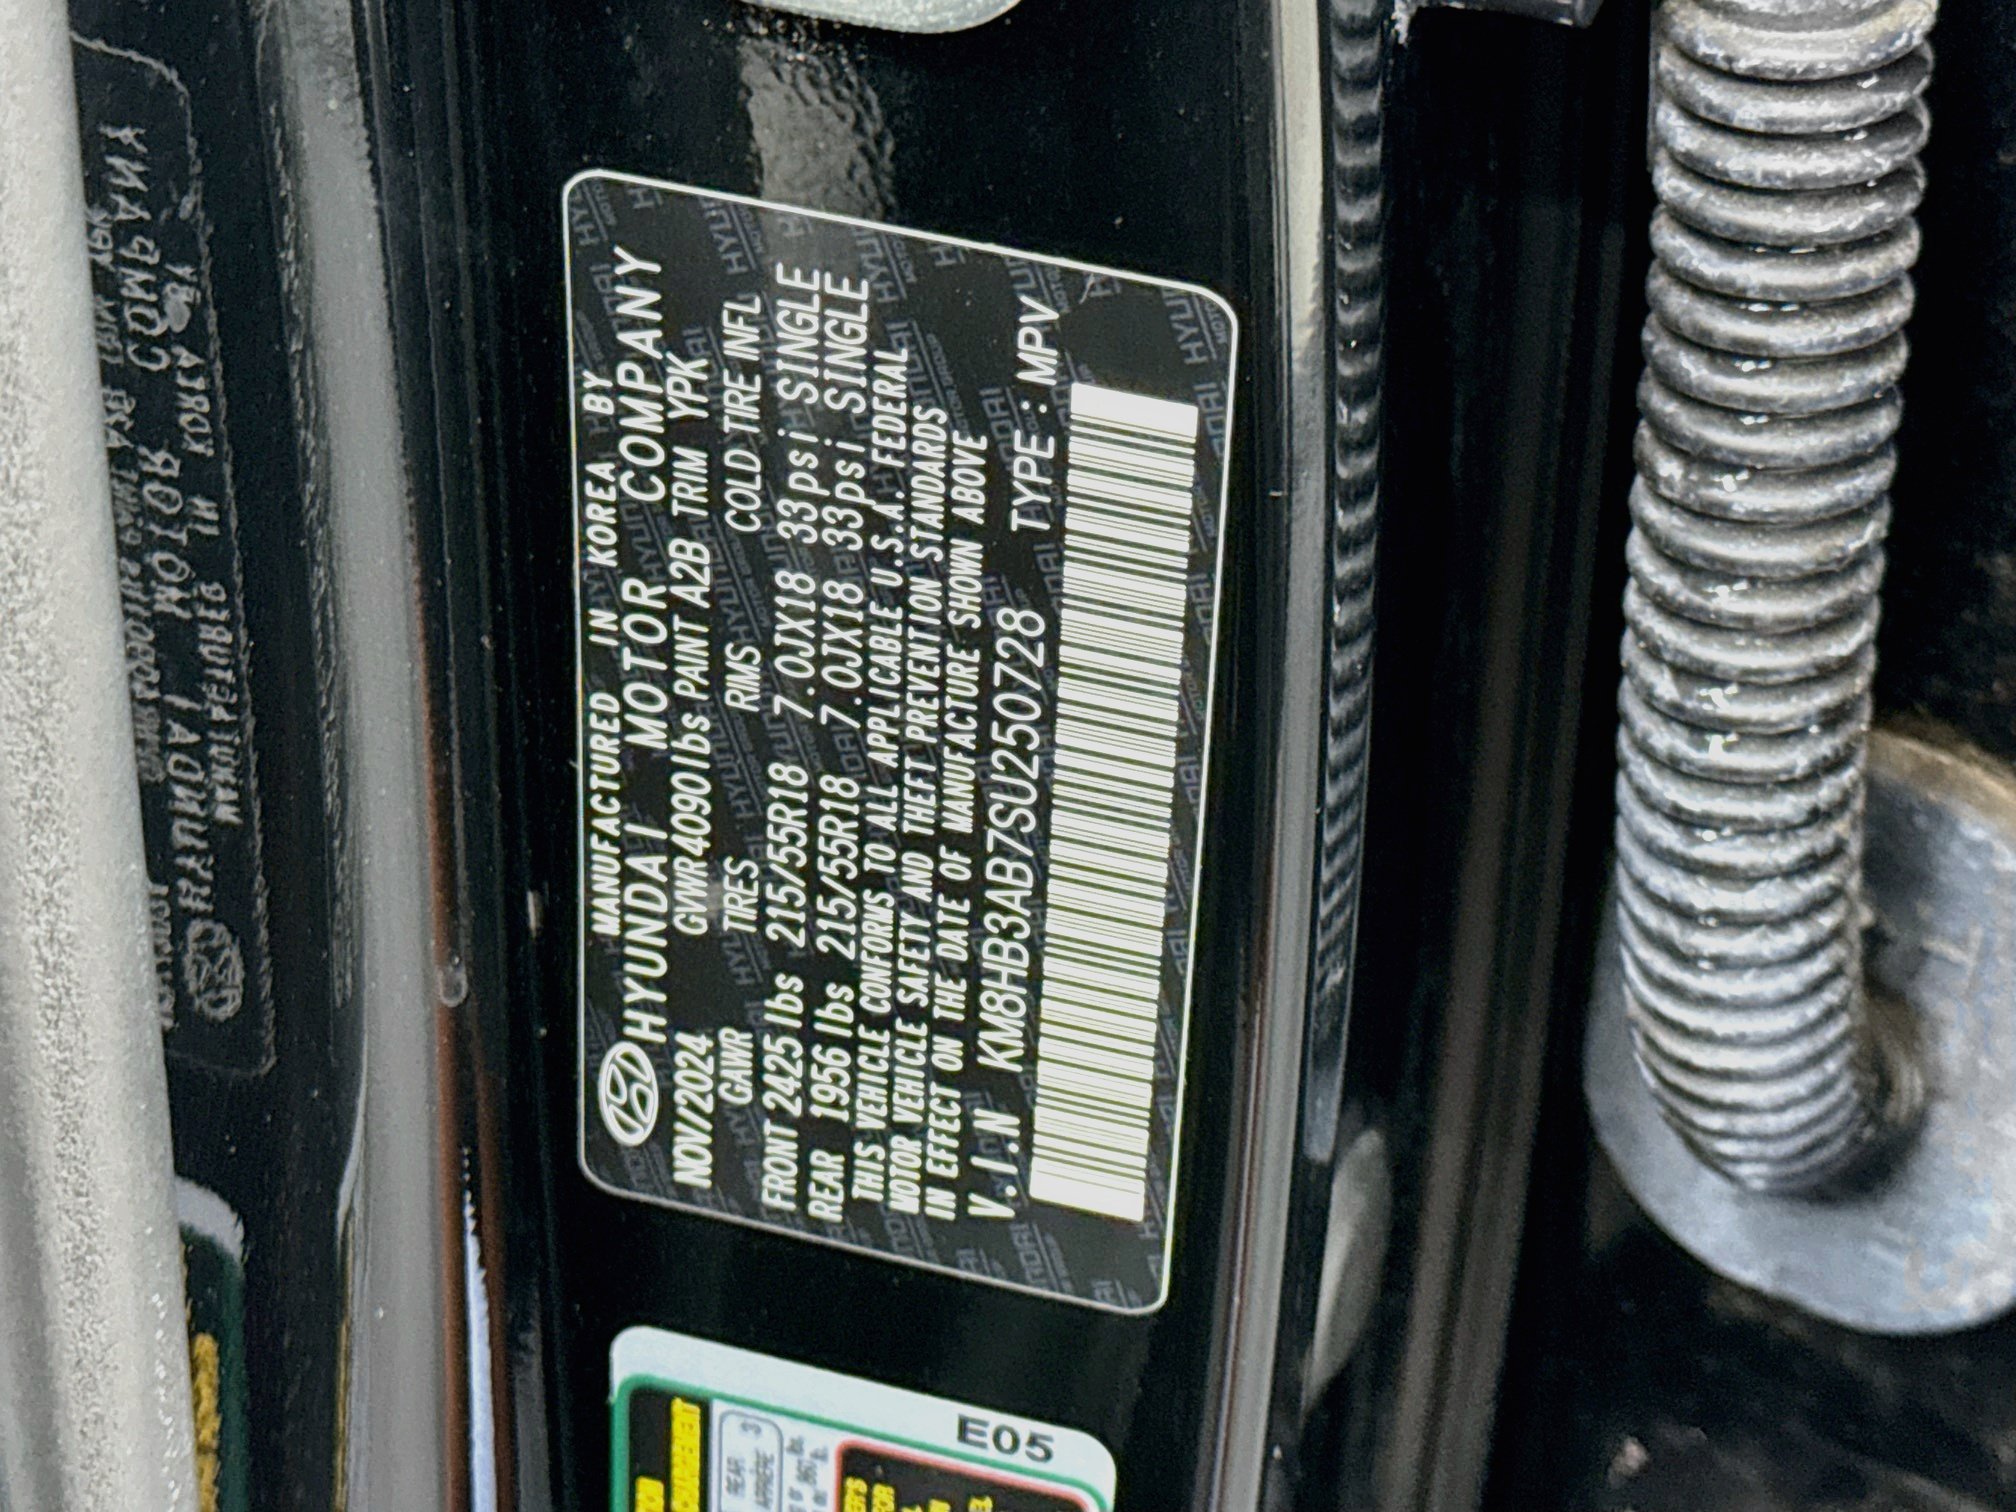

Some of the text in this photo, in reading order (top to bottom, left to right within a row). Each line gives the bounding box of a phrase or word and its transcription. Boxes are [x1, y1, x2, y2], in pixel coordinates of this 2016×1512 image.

[665, 351, 710, 420] YPK
[774, 261, 821, 405] SINGLE
[822, 271, 870, 415] SINGLE
[1015, 294, 1060, 387] MPV
[671, 445, 709, 518] TRIM
[909, 404, 949, 563] STANDARDS
[1010, 428, 1056, 532] TYPE
[613, 245, 669, 1044] HYUNDAI MOTOR COMPANY
[667, 537, 711, 609] A2B
[772, 568, 817, 720] 7.0JX18
[581, 369, 622, 937] MANUFACTURED IN KOREA BY
[672, 613, 710, 701] PAINT
[717, 294, 762, 1106] GAWR TIRES RIMS COLD TIRE INFL
[819, 579, 865, 730] 7.0JX18
[904, 575, 943, 744] PREVENTION
[850, 346, 910, 1203] THIS VEHICLE CONFORMS TO ALL APPLICABLE U.S.A. FEDERAL
[901, 754, 938, 836] THEFT
[924, 429, 989, 1221] IN EFFECT ON THE DATE OF MANUFACTURE SHOWN ABOVE
[976, 606, 1046, 1074] KM8HB3AB7SU250728
[764, 761, 810, 949] 215/55R18
[815, 773, 861, 961] 215/55R18
[900, 851, 935, 904] AND
[895, 910, 932, 1008] SAFETY
[671, 1031, 715, 1190] NOV/2024
[891, 1016, 929, 1124] VEHICLE
[760, 1119, 799, 1212] FRONT
[807, 1148, 846, 1223] REAR
[887, 1134, 923, 1215] MOTOR
[956, 1413, 1055, 1464] E05
